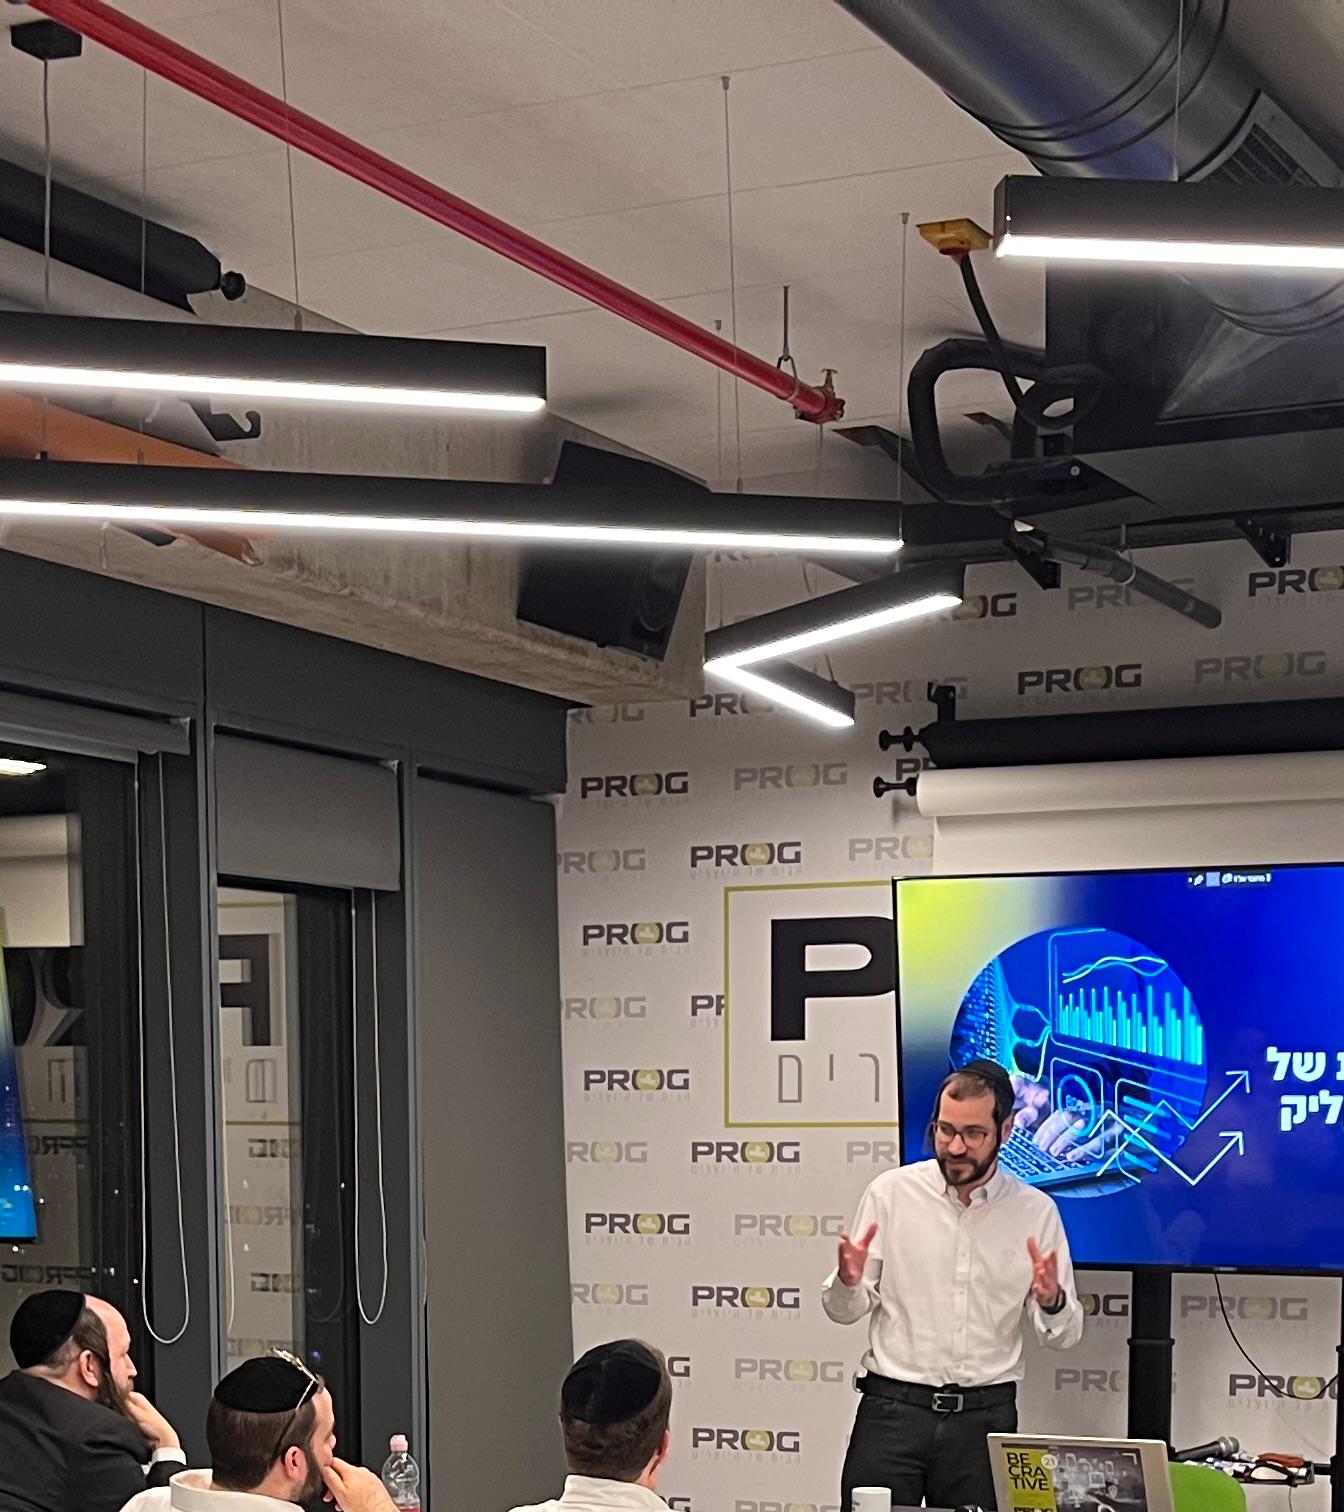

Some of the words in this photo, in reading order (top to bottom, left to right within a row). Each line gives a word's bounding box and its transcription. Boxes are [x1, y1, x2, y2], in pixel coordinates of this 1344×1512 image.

[1018, 664, 1142, 695] PROG
[581, 771, 688, 799] PROG
[690, 841, 801, 868] PROG
[849, 834, 933, 862] PRO
[583, 921, 689, 947] PROG
[561, 996, 646, 1020] ROG
[1266, 1047, 1326, 1081] של
[584, 1069, 689, 1091] PROG
[567, 1141, 648, 1163] ROG
[692, 1141, 800, 1163] PROG
[846, 1141, 897, 1163] PR
[586, 1213, 690, 1235] PROG
[571, 1283, 648, 1305] ROG
[692, 1286, 800, 1309] PROG
[1180, 1295, 1308, 1321] PROG
[692, 1428, 800, 1452] PROG
[1007, 1452, 1031, 1466] BE
[1011, 1477, 1050, 1491] TIVE
